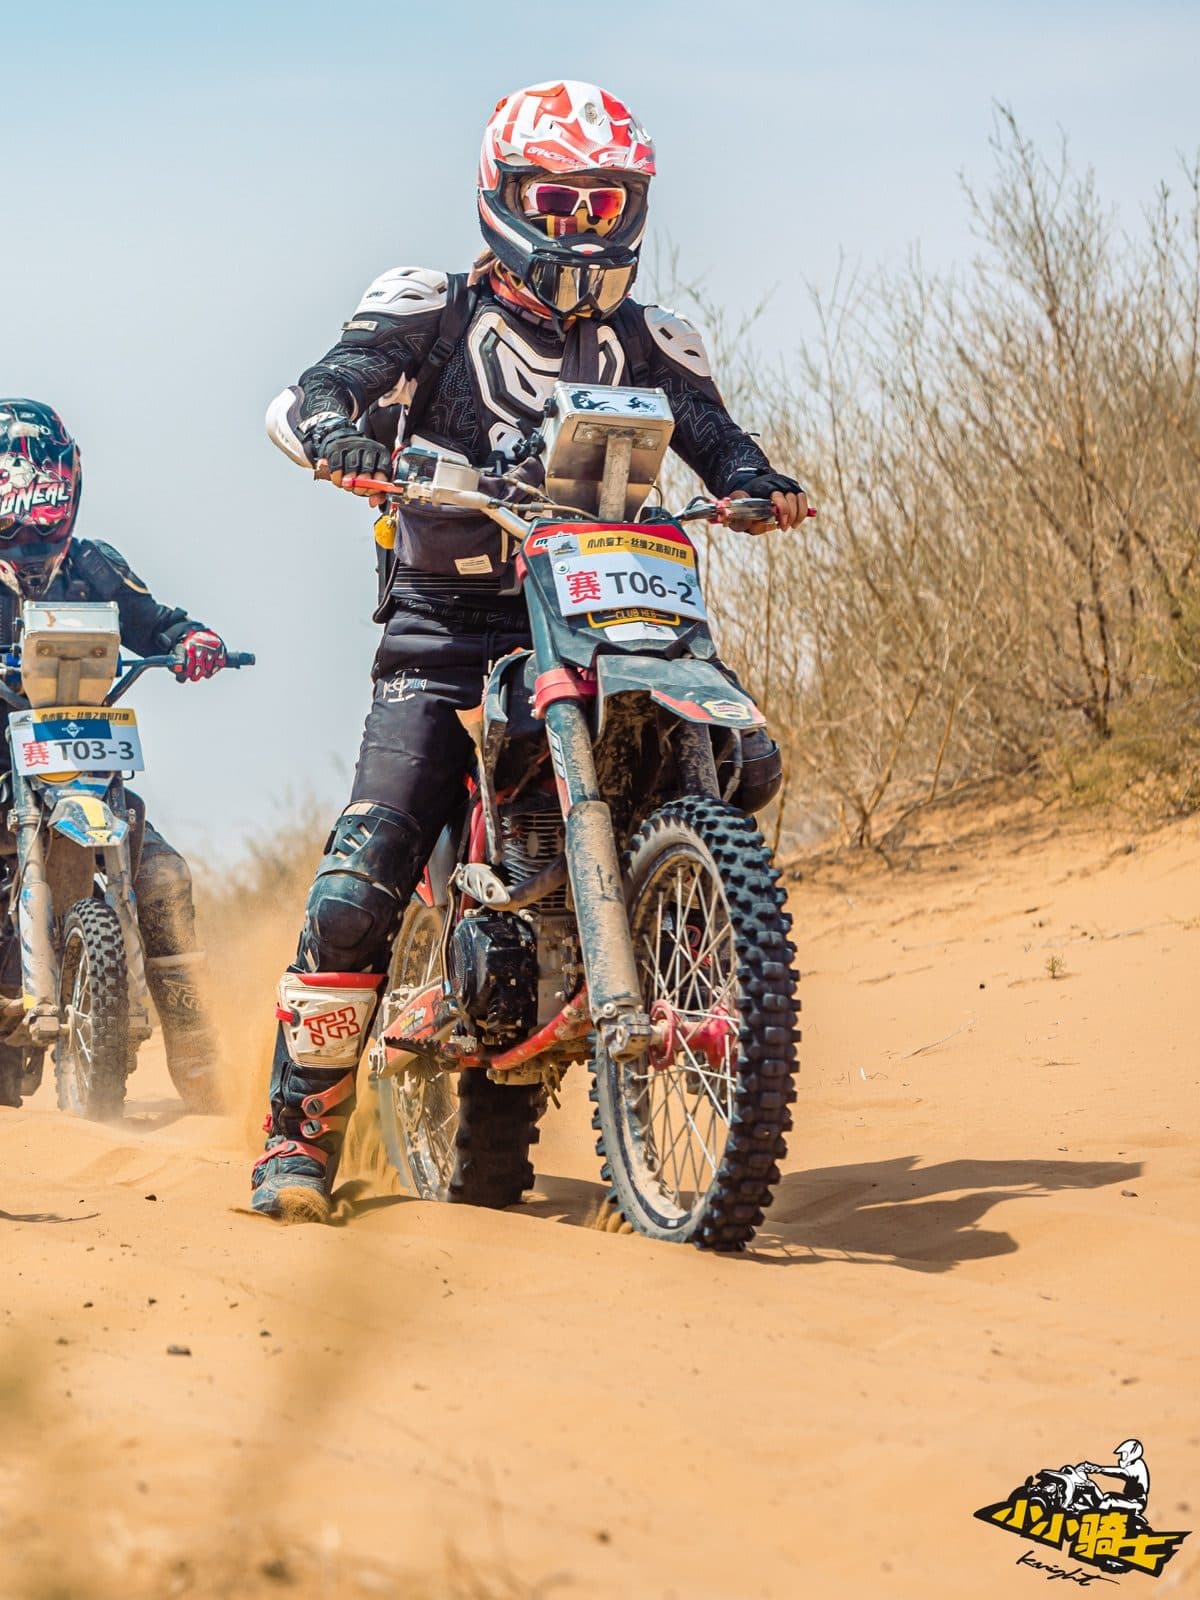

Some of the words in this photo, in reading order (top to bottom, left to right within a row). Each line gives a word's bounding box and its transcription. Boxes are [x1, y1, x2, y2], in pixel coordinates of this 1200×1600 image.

[566, 570, 602, 604] 赛
[606, 571, 697, 606] T06-2
[615, 609, 639, 619] CLUB
[22, 740, 49, 768] 赛
[55, 740, 135, 760] T03-3
